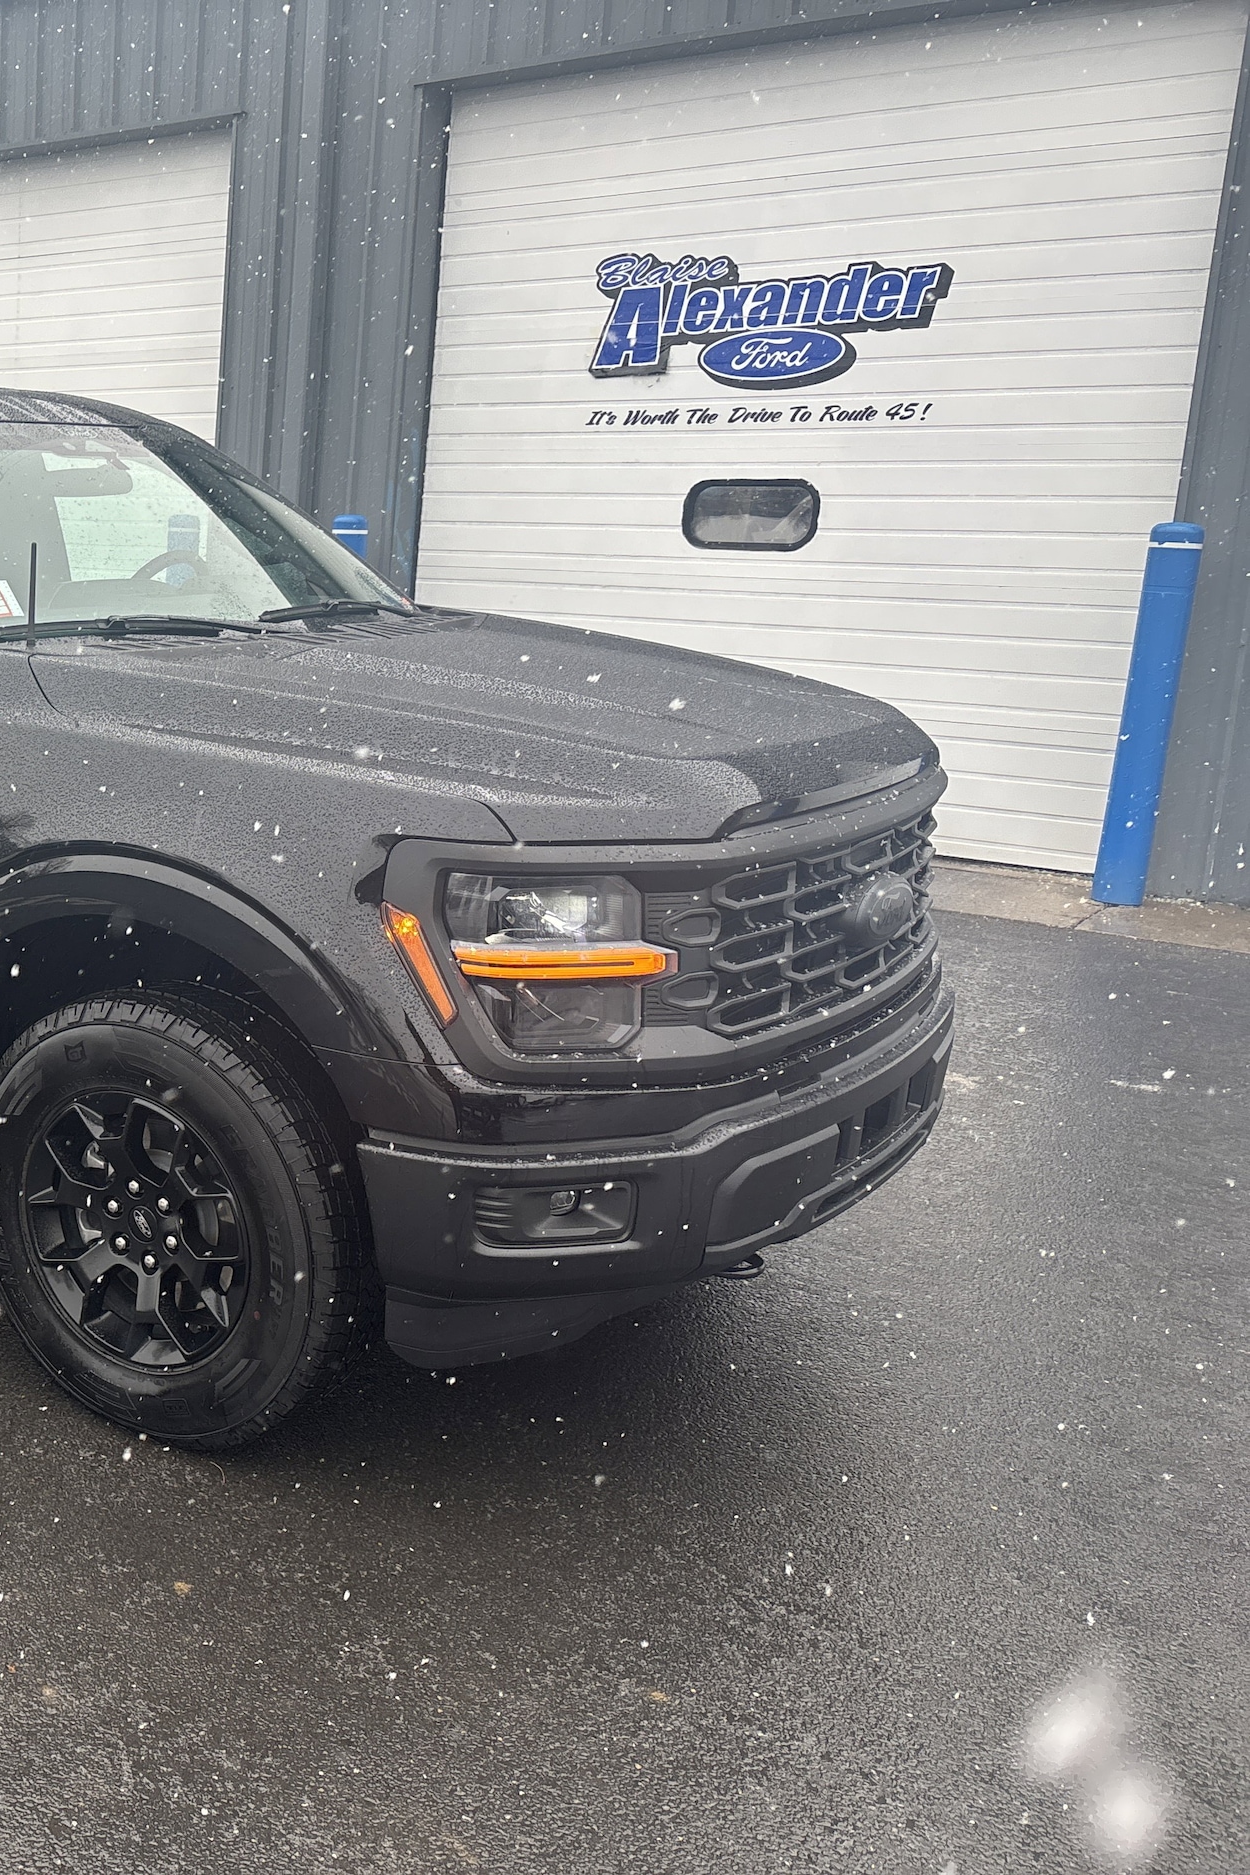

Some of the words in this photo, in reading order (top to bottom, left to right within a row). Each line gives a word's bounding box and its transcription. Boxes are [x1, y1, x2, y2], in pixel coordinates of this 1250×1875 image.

[598, 255, 730, 290] Blaise
[593, 263, 943, 369] Alexander
[731, 337, 810, 371] Ford
[585, 410, 617, 426] It's
[623, 408, 680, 426] Worth
[686, 407, 719, 425] The
[727, 406, 783, 424] Drive
[790, 405, 812, 423] To
[819, 404, 878, 422] Route
